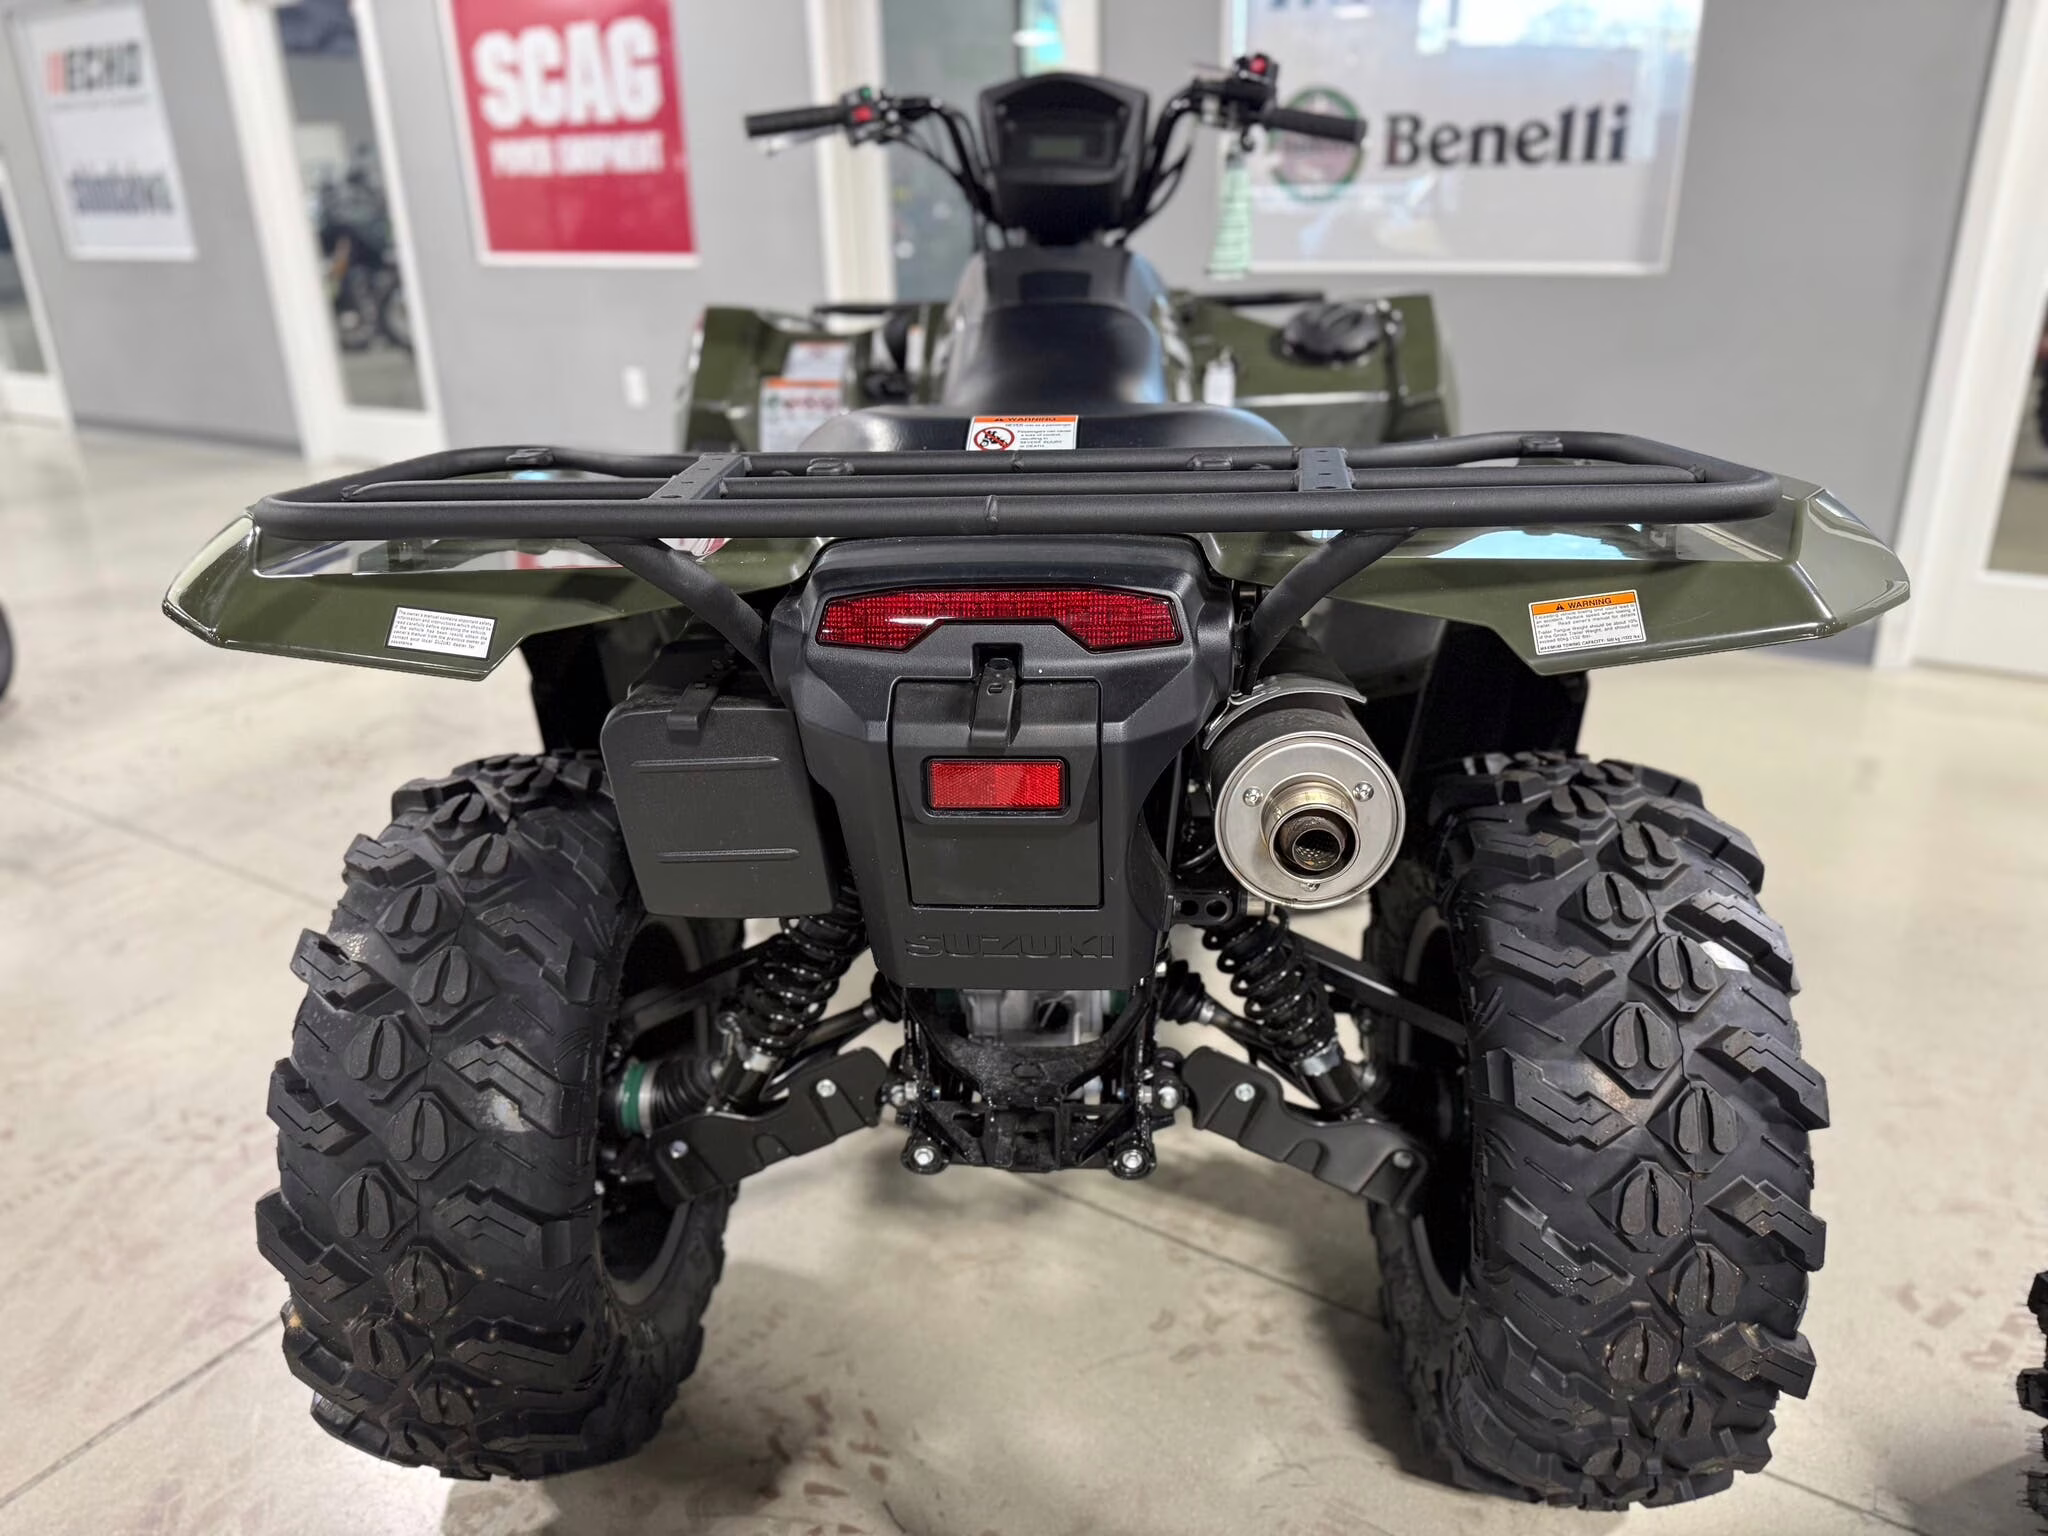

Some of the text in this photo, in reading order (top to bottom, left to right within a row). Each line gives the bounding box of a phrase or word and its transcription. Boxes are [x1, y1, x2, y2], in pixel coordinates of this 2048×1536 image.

[66, 41, 142, 92] ECHO
[472, 15, 664, 130] SCAG
[1383, 103, 1631, 168] Benelli
[1567, 597, 1612, 608] WARNING
[903, 933, 1115, 960] SUZUKI
